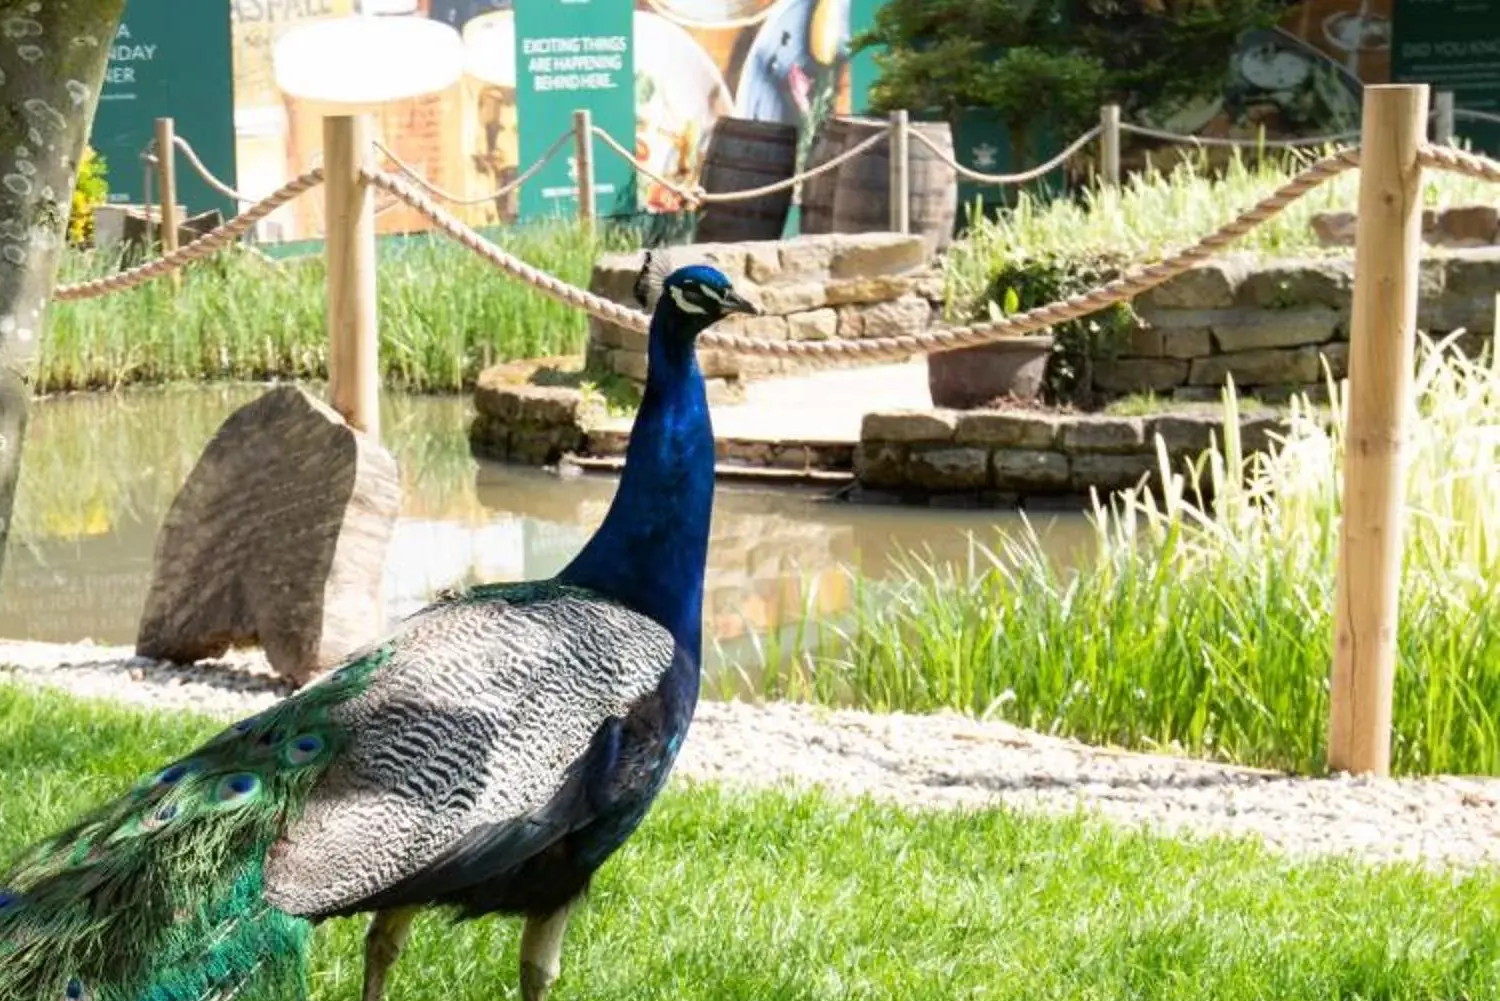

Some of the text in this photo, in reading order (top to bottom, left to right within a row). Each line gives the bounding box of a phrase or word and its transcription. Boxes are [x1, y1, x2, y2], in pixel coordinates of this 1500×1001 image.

[523, 36, 627, 54] EXCITING THINGS
[528, 54, 623, 72] ARE HAPPENING
[534, 74, 580, 91] BEHIND
